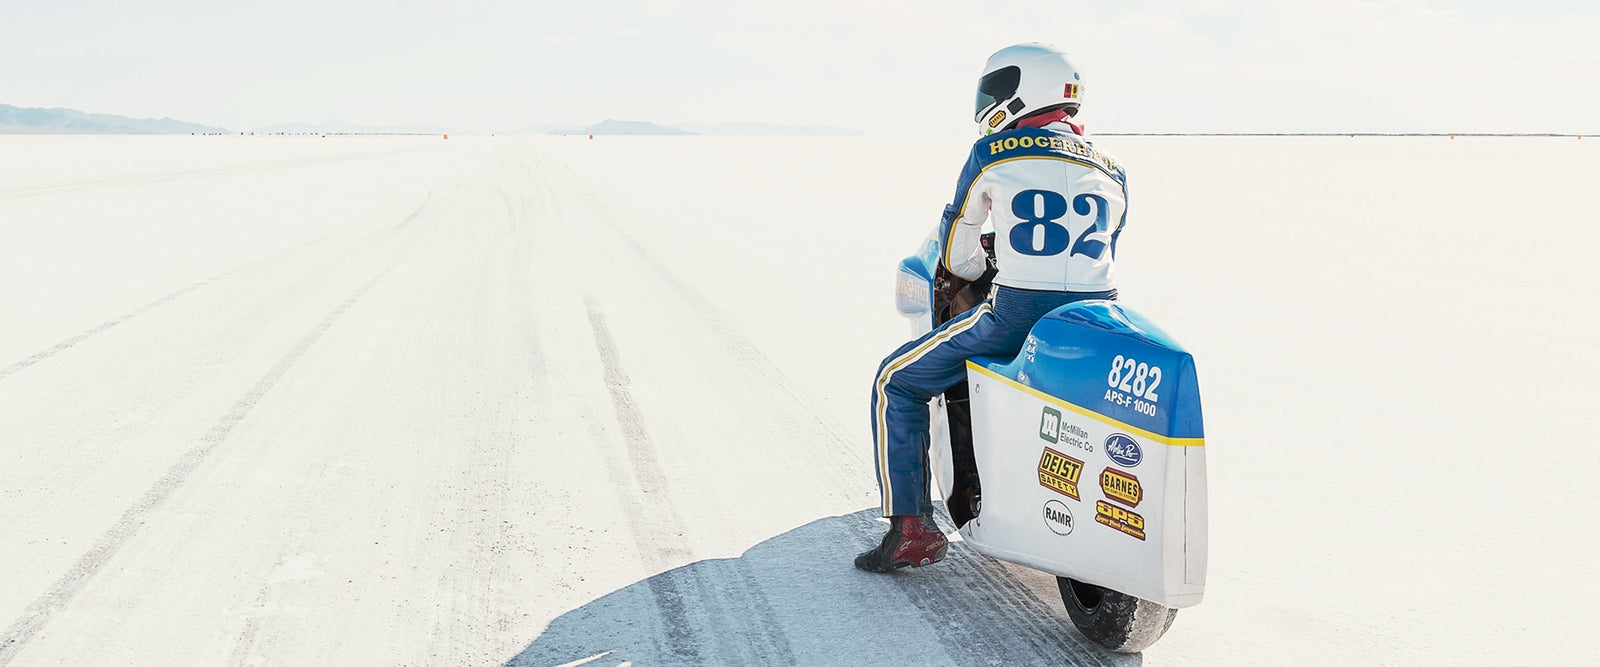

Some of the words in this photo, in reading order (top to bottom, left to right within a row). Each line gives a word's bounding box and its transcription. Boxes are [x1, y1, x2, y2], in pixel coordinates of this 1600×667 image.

[989, 136, 1117, 171] HOOGERH
[1009, 189, 1109, 260] 82
[1108, 354, 1162, 403] 8282
[1104, 389, 1132, 408] APS-F
[1133, 399, 1156, 417] 1000
[1060, 432, 1083, 449] Electric
[1084, 441, 1094, 453] Co
[1061, 421, 1088, 439] McMillan
[1042, 452, 1079, 480] DEIST
[1040, 474, 1075, 494] SAFETY
[1104, 474, 1138, 497] BARNES
[1045, 507, 1071, 527] RAMR
